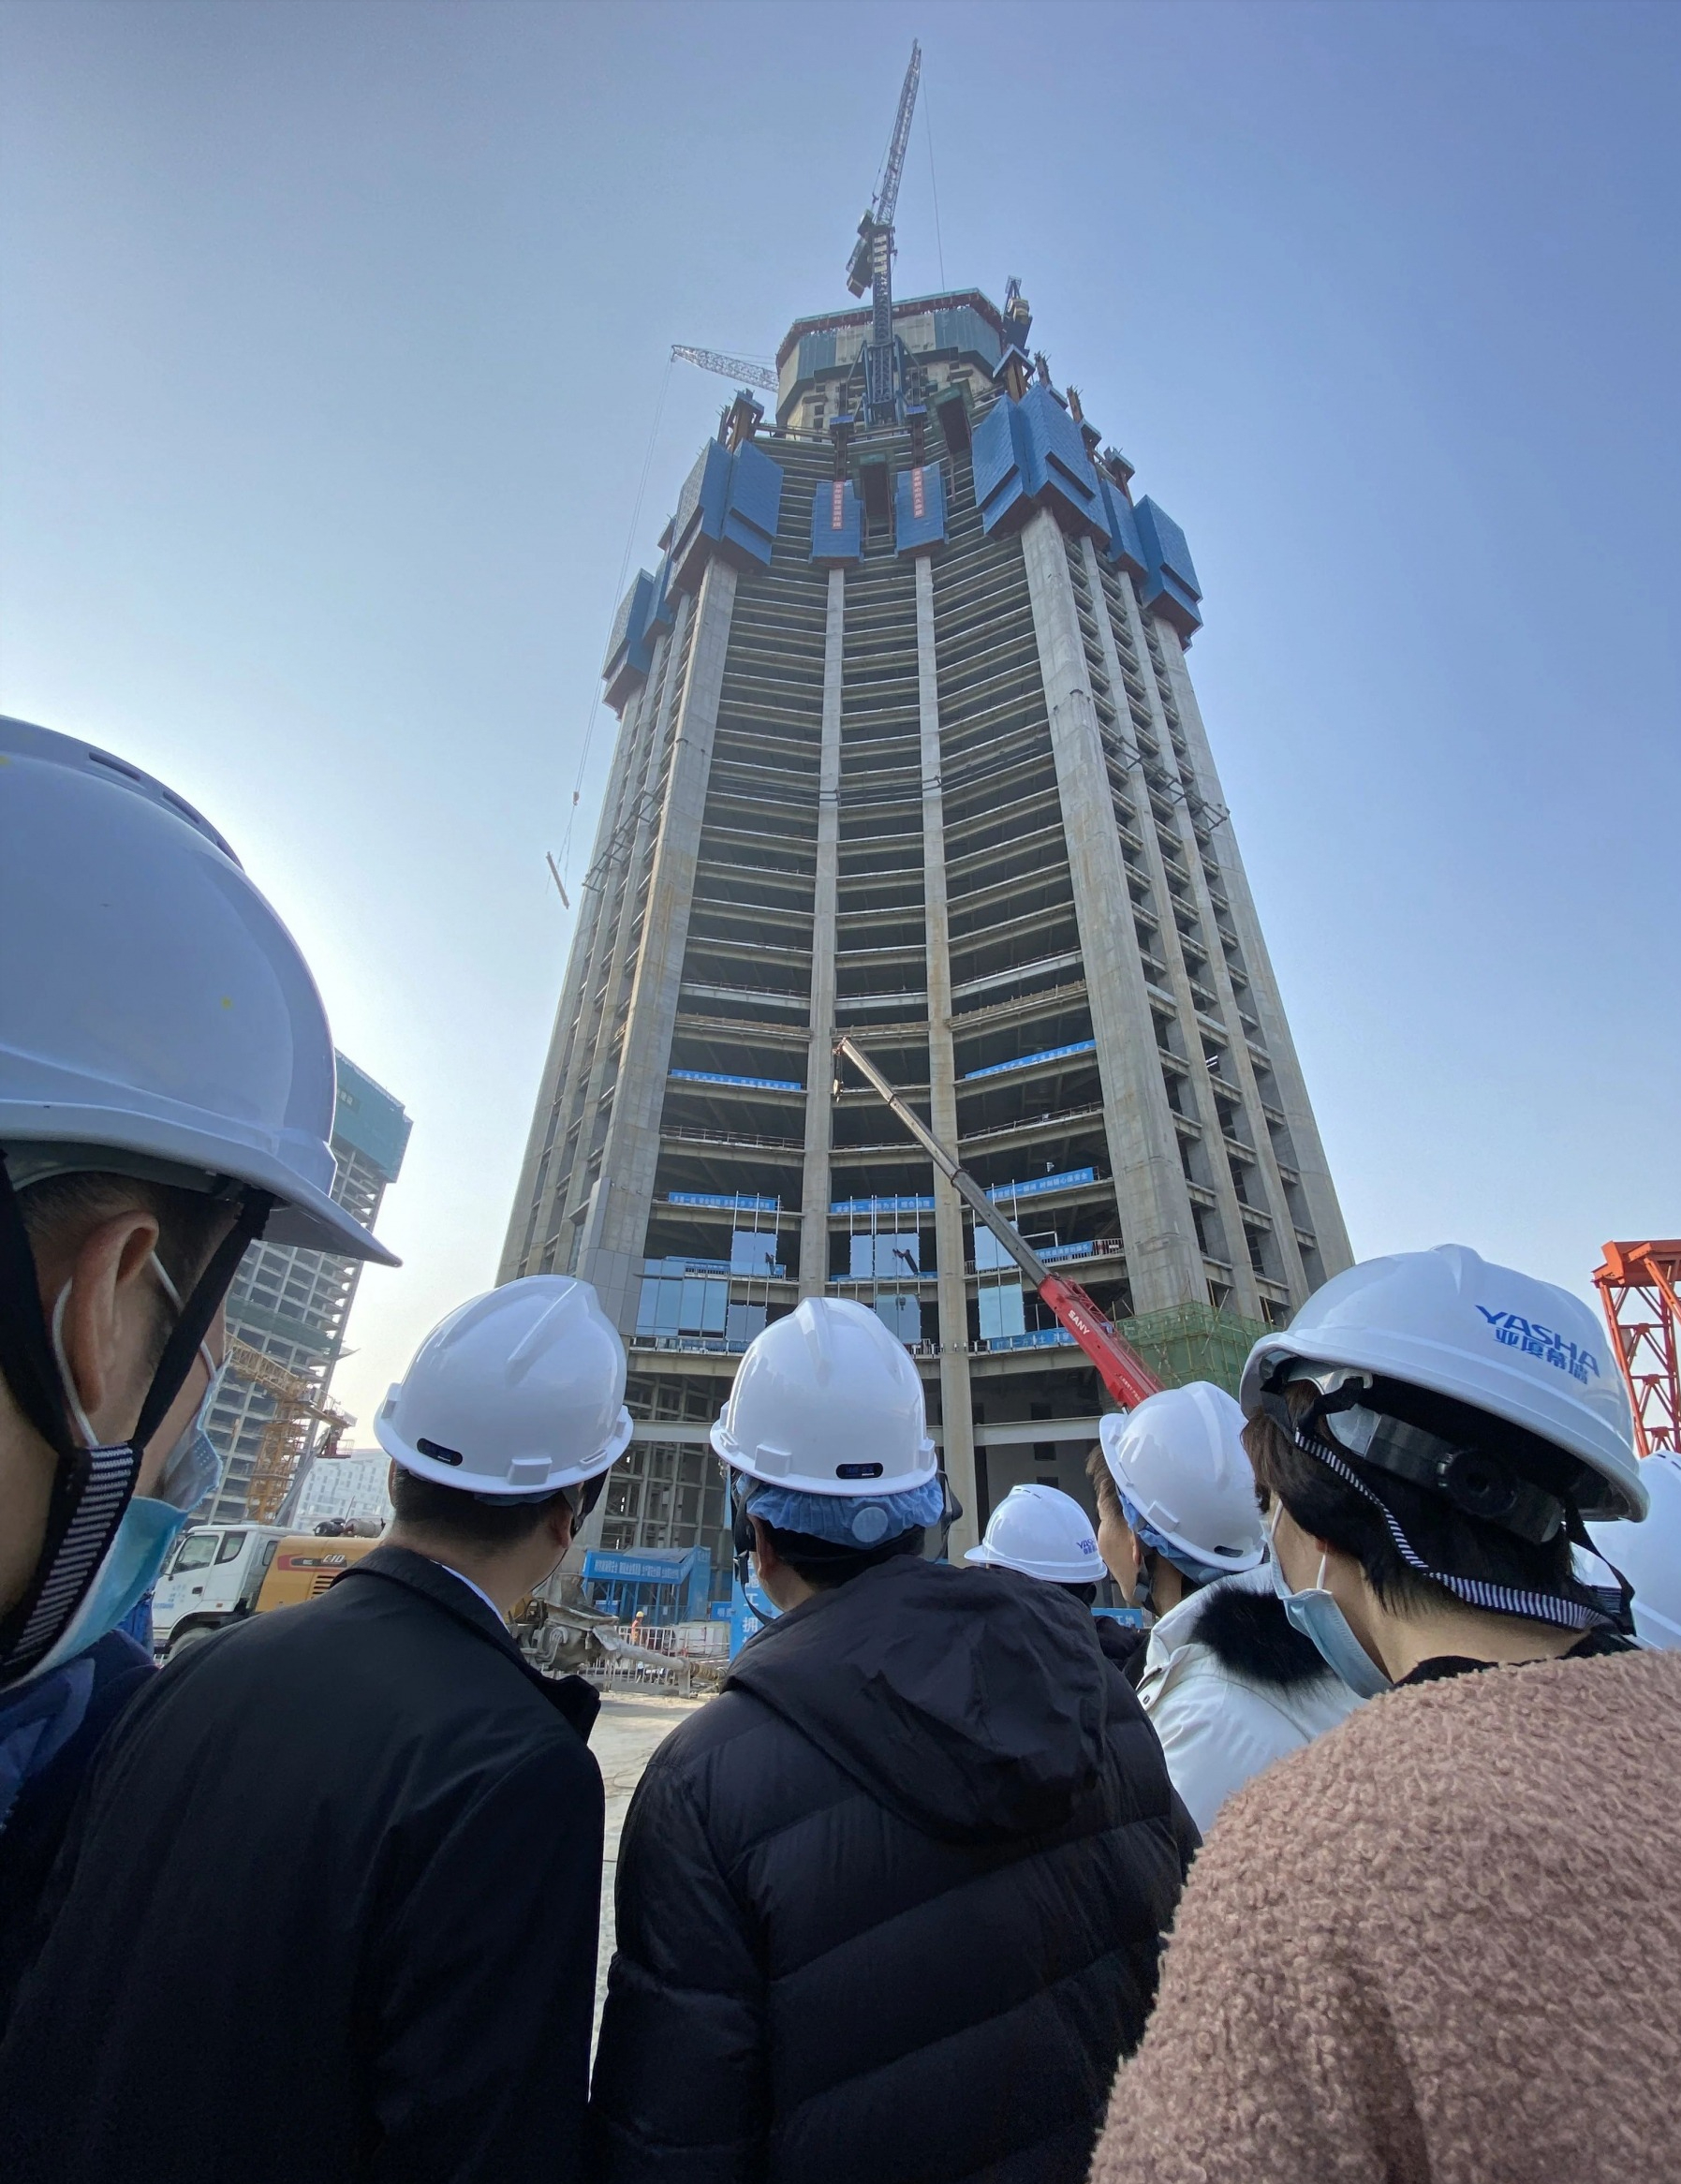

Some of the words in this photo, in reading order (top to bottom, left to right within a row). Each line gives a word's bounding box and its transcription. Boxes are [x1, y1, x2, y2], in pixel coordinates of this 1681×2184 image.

[1068, 1309, 1090, 1335] SANY
[1474, 1305, 1600, 1379] YASHA
[1493, 1327, 1588, 1385] 亚厦幕墙
